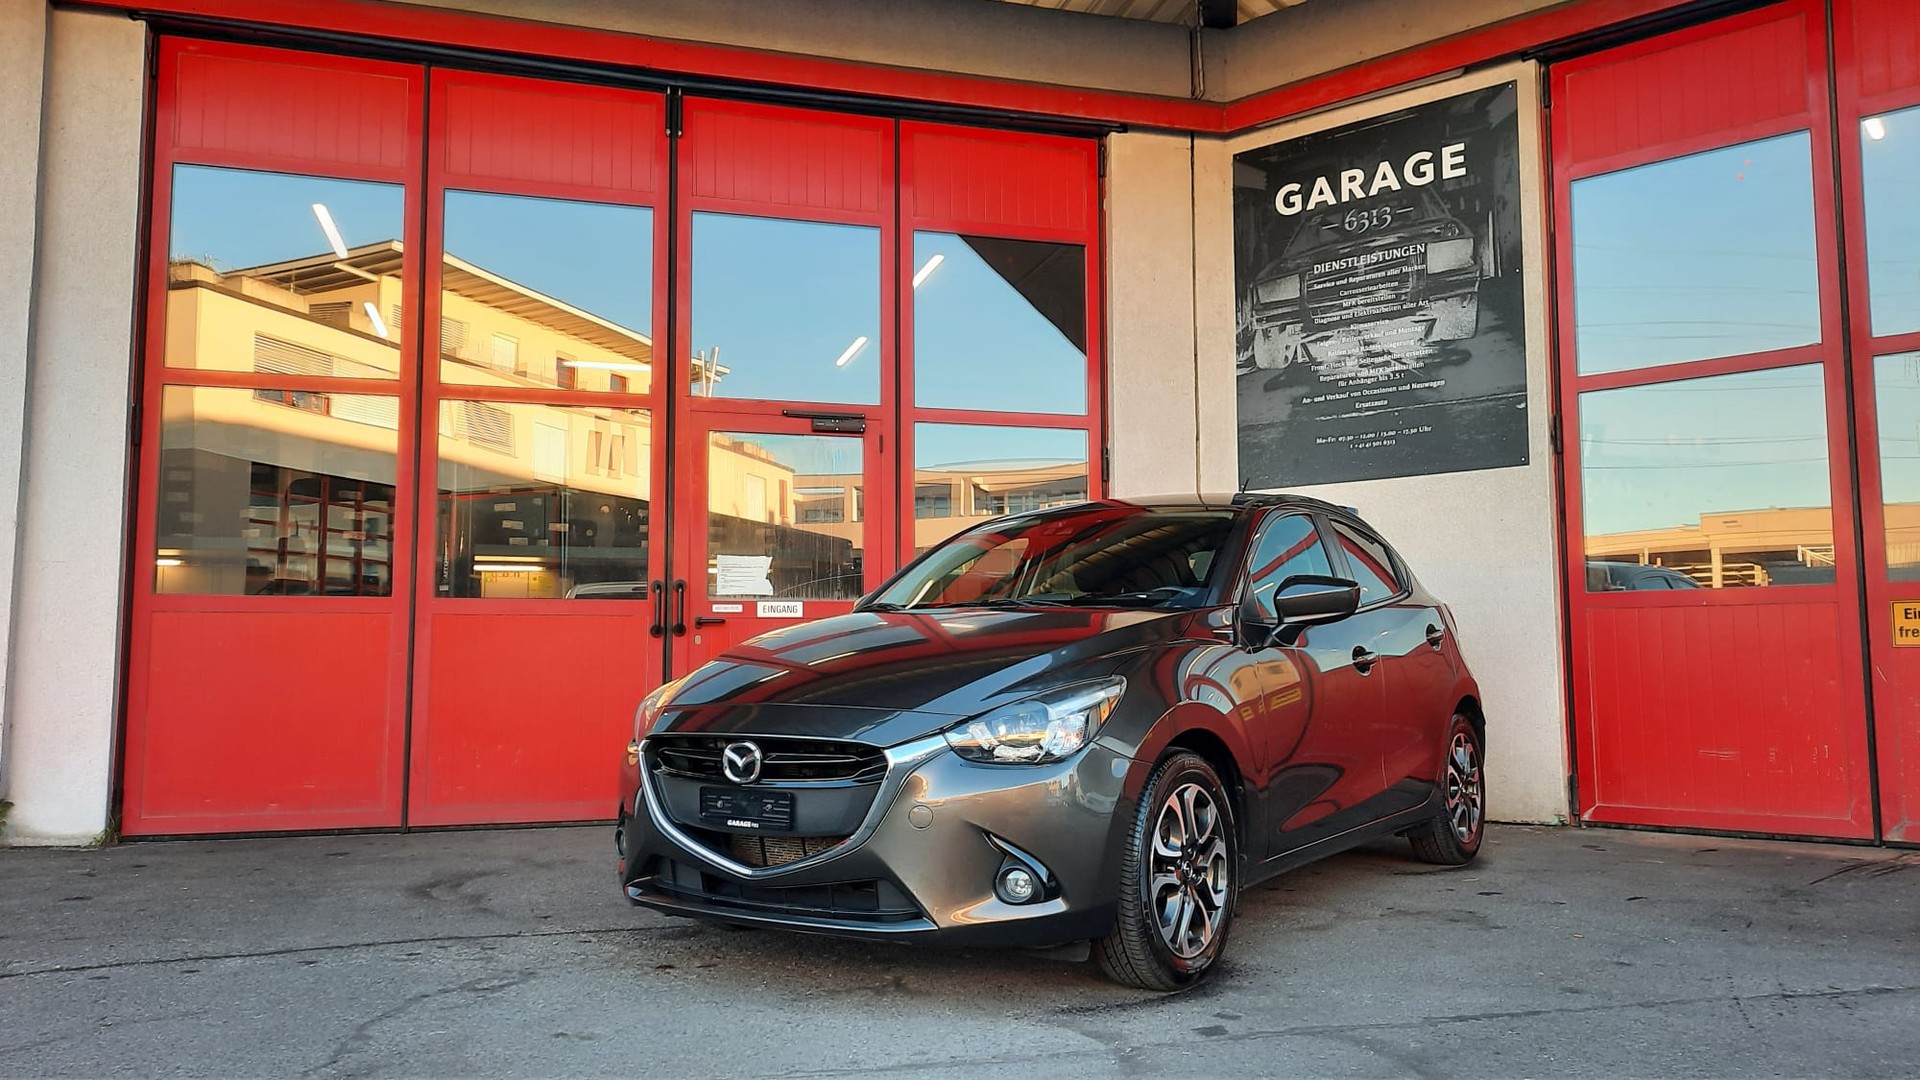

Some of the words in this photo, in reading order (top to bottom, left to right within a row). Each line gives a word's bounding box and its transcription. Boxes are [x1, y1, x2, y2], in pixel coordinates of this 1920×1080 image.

[1275, 142, 1466, 216] GARAGE
[1344, 206, 1392, 234] 6313
[1313, 243, 1426, 274] DIENSTLEISTUNGEN
[1313, 281, 1335, 289] Service
[1387, 268, 1401, 276] aller
[1402, 264, 1426, 273] Marken
[1314, 315, 1340, 325] Diagnose
[1342, 312, 1353, 320] und
[1402, 301, 1416, 309] aller
[1418, 299, 1429, 307] Art
[1319, 372, 1356, 382] Reparaturen
[1357, 369, 1368, 377] und
[1338, 379, 1347, 387] für
[1348, 376, 1378, 386] Anhänger
[1326, 392, 1349, 401] Verkauf
[1362, 386, 1397, 396] Occasionen
[1411, 379, 1446, 390] Neuwagen
[1355, 399, 1389, 409] Ersatzauto
[1419, 425, 1432, 433] Uhr
[762, 604, 798, 614] EINGANG
[1904, 607, 1920, 620] Ei
[727, 820, 751, 828] GARAGE
